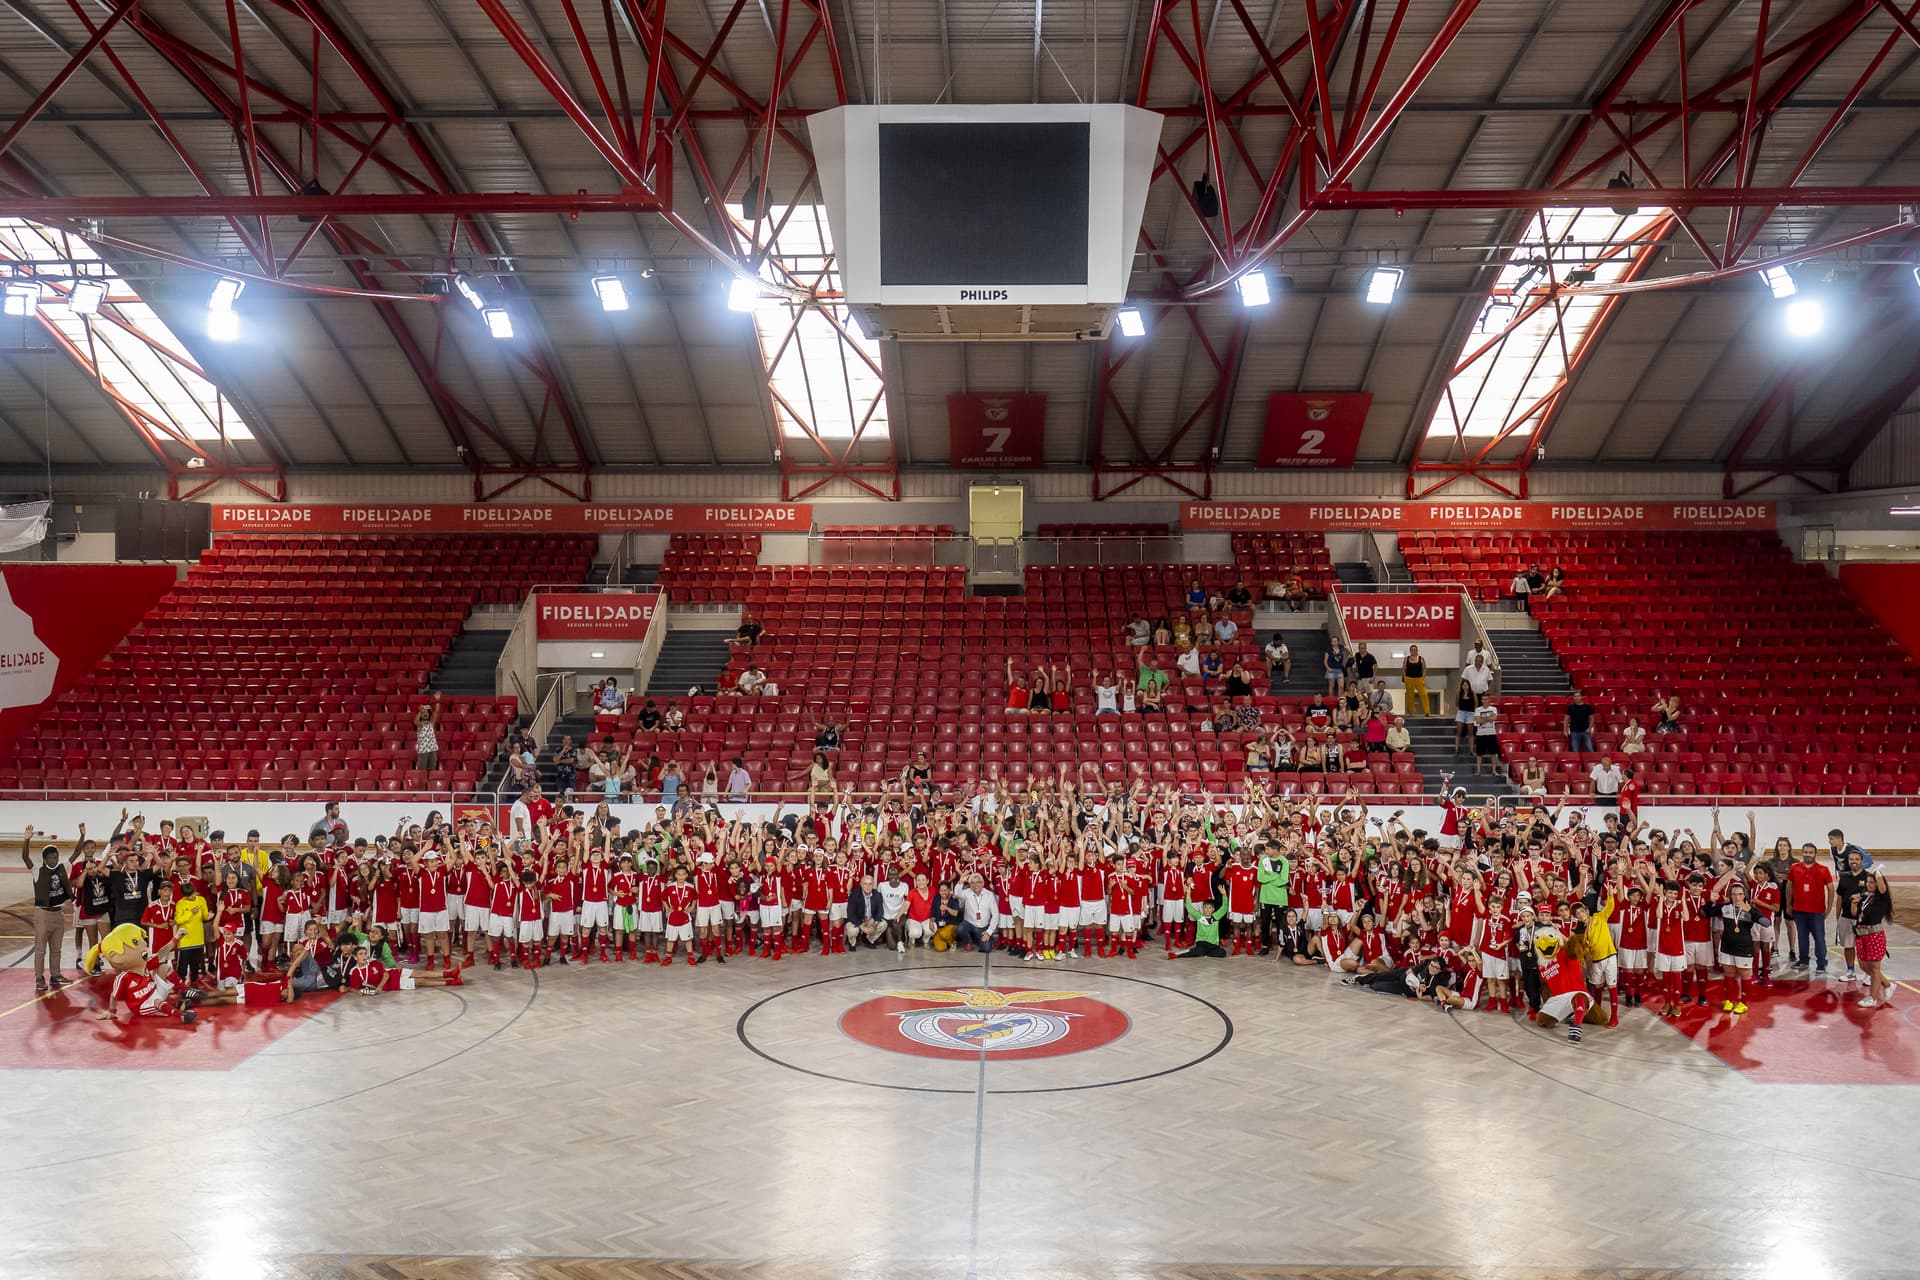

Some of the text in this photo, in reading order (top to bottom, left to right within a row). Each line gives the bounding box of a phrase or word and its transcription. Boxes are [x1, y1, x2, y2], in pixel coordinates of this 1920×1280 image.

[960, 290, 1008, 300] PHILIPS
[982, 427, 1011, 453] 7
[1297, 429, 1326, 455] 2
[223, 509, 312, 521] FIDELIDADE
[343, 509, 432, 521] FIDELIDADE
[463, 509, 553, 521] FIDELIDADE
[584, 509, 674, 521] FIDELIDADE
[705, 508, 795, 521] FIDELIDADE
[1189, 507, 1281, 519] FIDELIDADE
[1309, 507, 1401, 520] FIDELIDADE
[1430, 507, 1523, 519] FIDELIDADE
[1551, 507, 1645, 519] FIDELIDADE
[1673, 506, 1766, 519] FIDELIDADE
[542, 606, 653, 620] FIDELIDADE
[1342, 606, 1455, 620] FIDELIDADE
